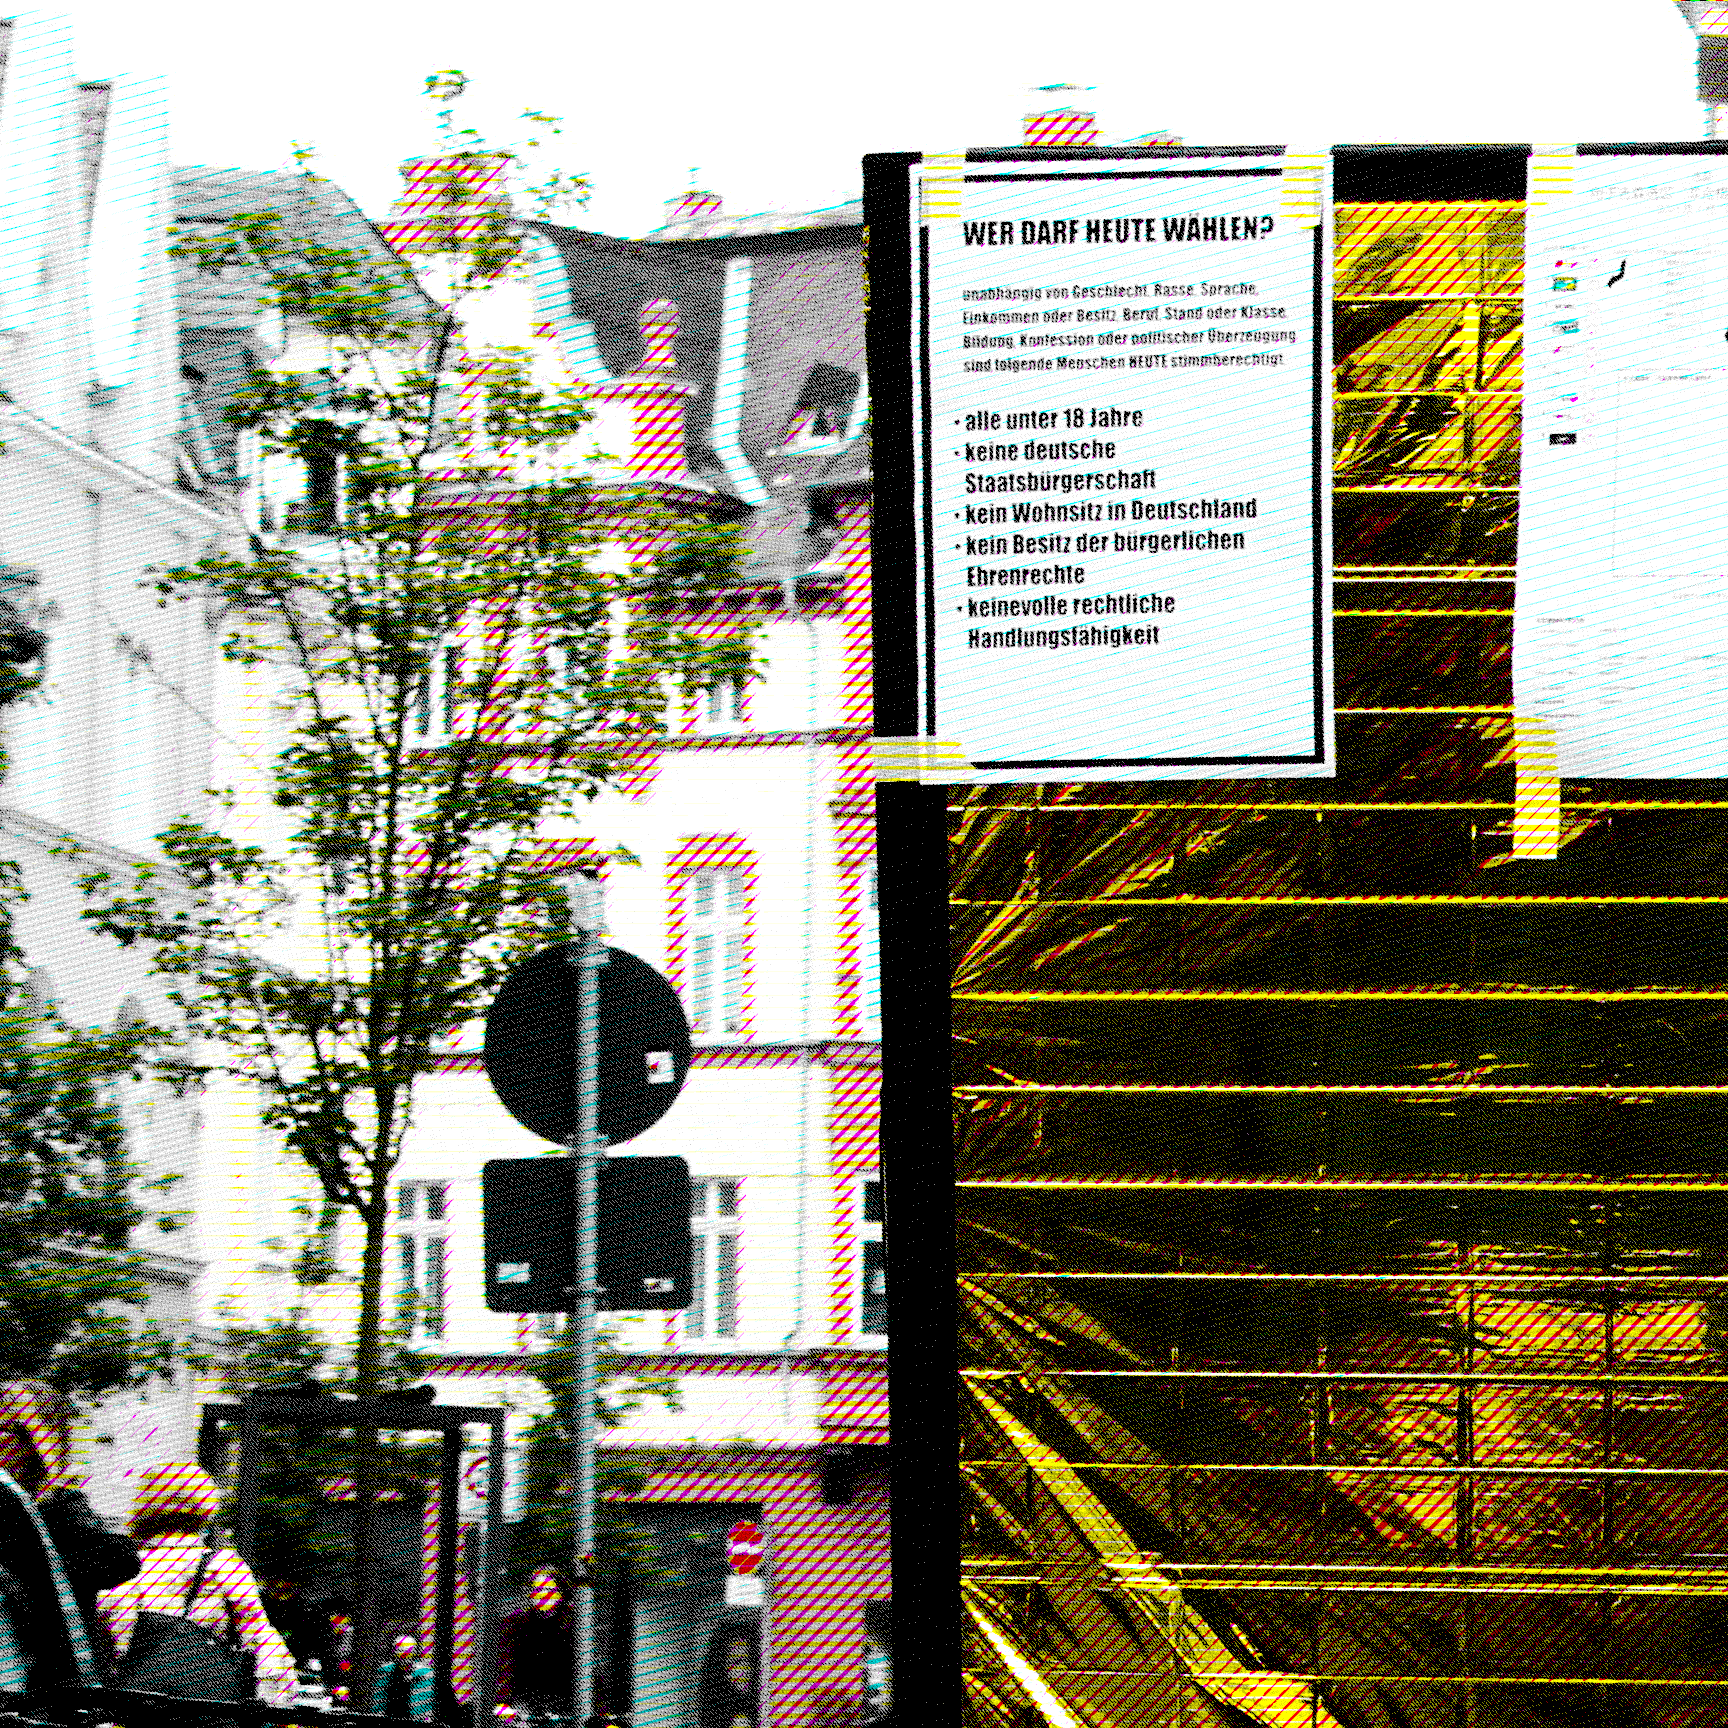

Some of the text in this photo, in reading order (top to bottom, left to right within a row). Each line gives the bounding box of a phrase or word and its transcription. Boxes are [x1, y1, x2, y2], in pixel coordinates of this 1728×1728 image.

[963, 211, 1274, 246] WER DARF HEUTE WÄHLEN?
[1046, 288, 1068, 298] von
[963, 312, 1039, 324] Einkommen
[1043, 310, 1072, 322] oder
[1165, 307, 1202, 320] Stand
[1207, 307, 1237, 319] oder
[1020, 334, 1094, 346] Konfession
[1098, 333, 1127, 345] oder
[1131, 331, 1204, 345] politischer
[964, 359, 991, 372] sind
[995, 358, 1052, 373] folgende
[1058, 357, 1125, 369] Menschen
[1129, 355, 1166, 368] HEUTE
[965, 407, 1143, 431] alle unter 18 Jahre
[965, 439, 1116, 462] keine deutsche
[965, 469, 1156, 494] Staatsbürgerschaft
[966, 498, 1257, 524] kein Wohnsitz in Deutschland
[966, 530, 1245, 555] kein Besitz der bürgerlichen
[967, 564, 1085, 587] Ehrenrechte
[1073, 593, 1175, 615] rechtliche
[969, 625, 1159, 649] Handlungsfähigkeit
